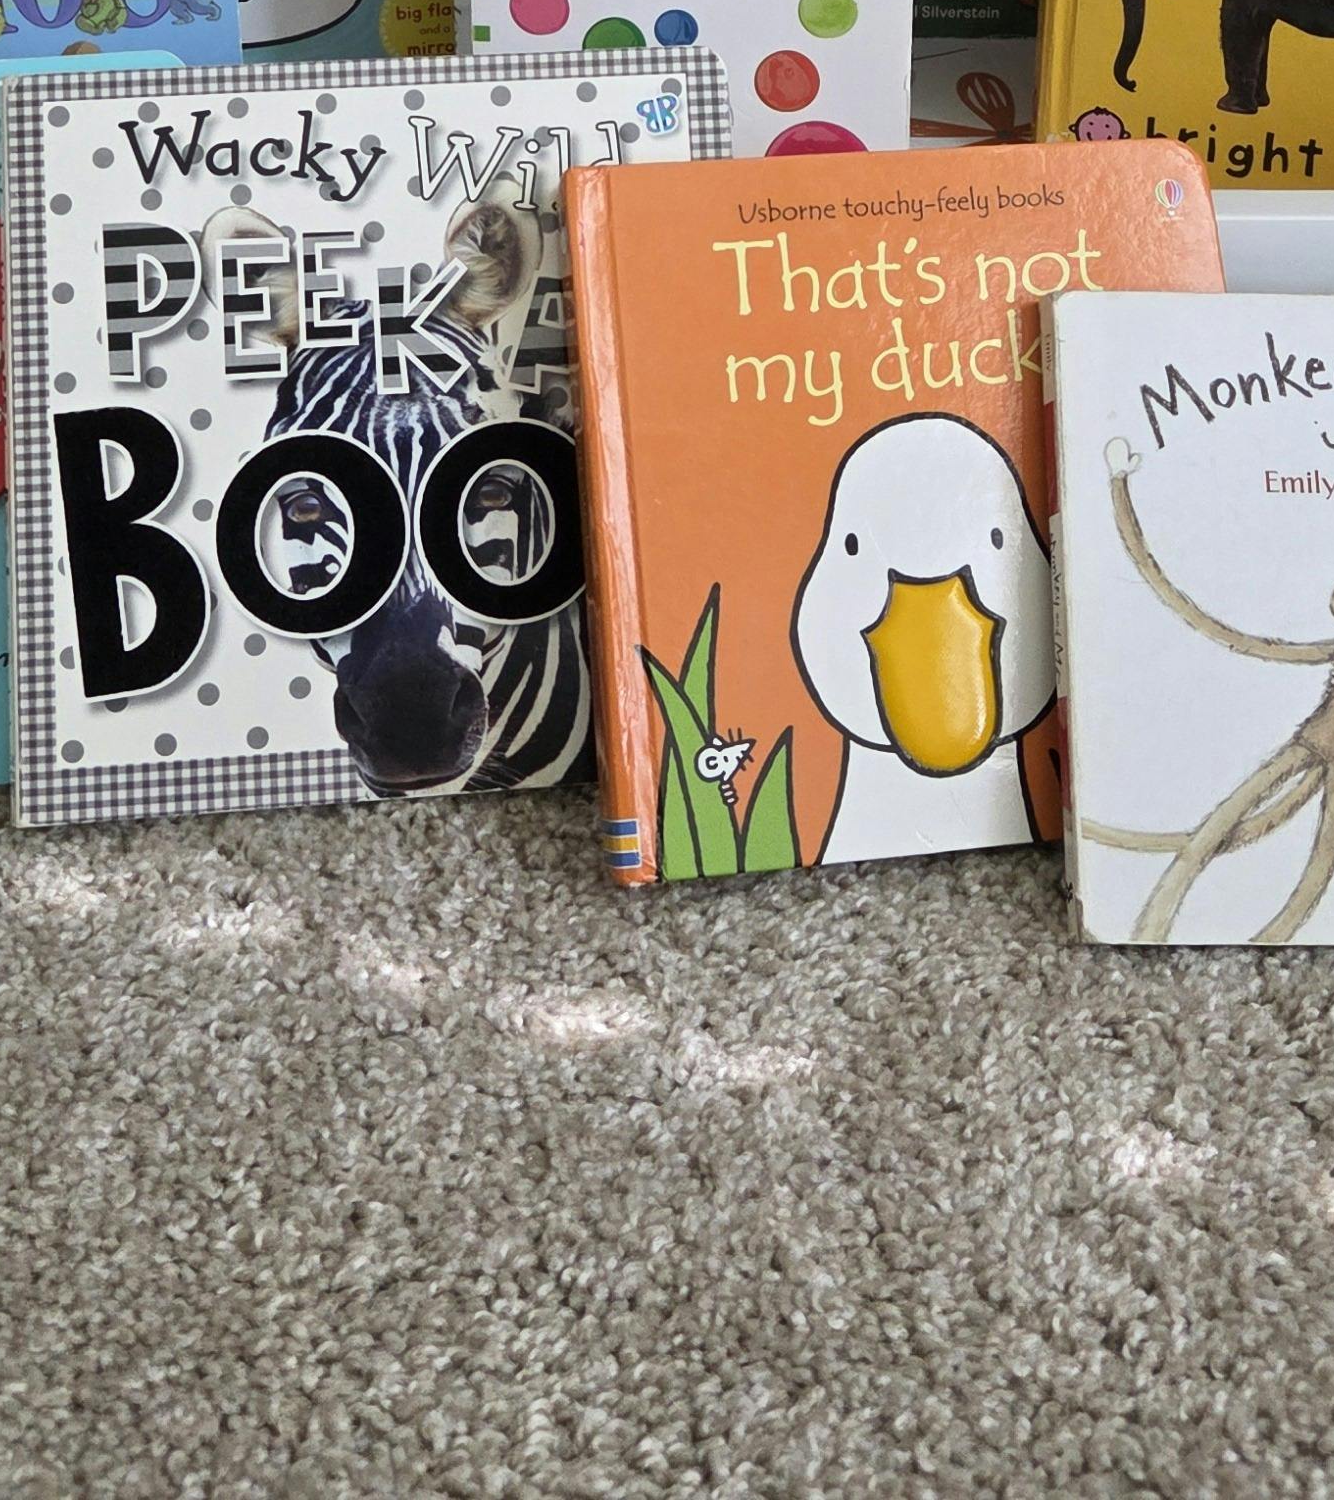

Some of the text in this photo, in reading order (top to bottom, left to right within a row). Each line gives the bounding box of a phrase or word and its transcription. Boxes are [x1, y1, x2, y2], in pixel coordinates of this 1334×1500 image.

[396, 2, 453, 23] big fla
[419, 24, 441, 35] and
[921, 5, 1000, 19] Silverstein
[407, 41, 455, 56] mirro
[119, 109, 387, 202] Wacky
[738, 187, 1066, 227] Usborne touchy-feely books
[712, 229, 1104, 317] That's not
[101, 222, 471, 396] PEEK
[725, 342, 843, 428] my
[52, 405, 589, 702] BOO
